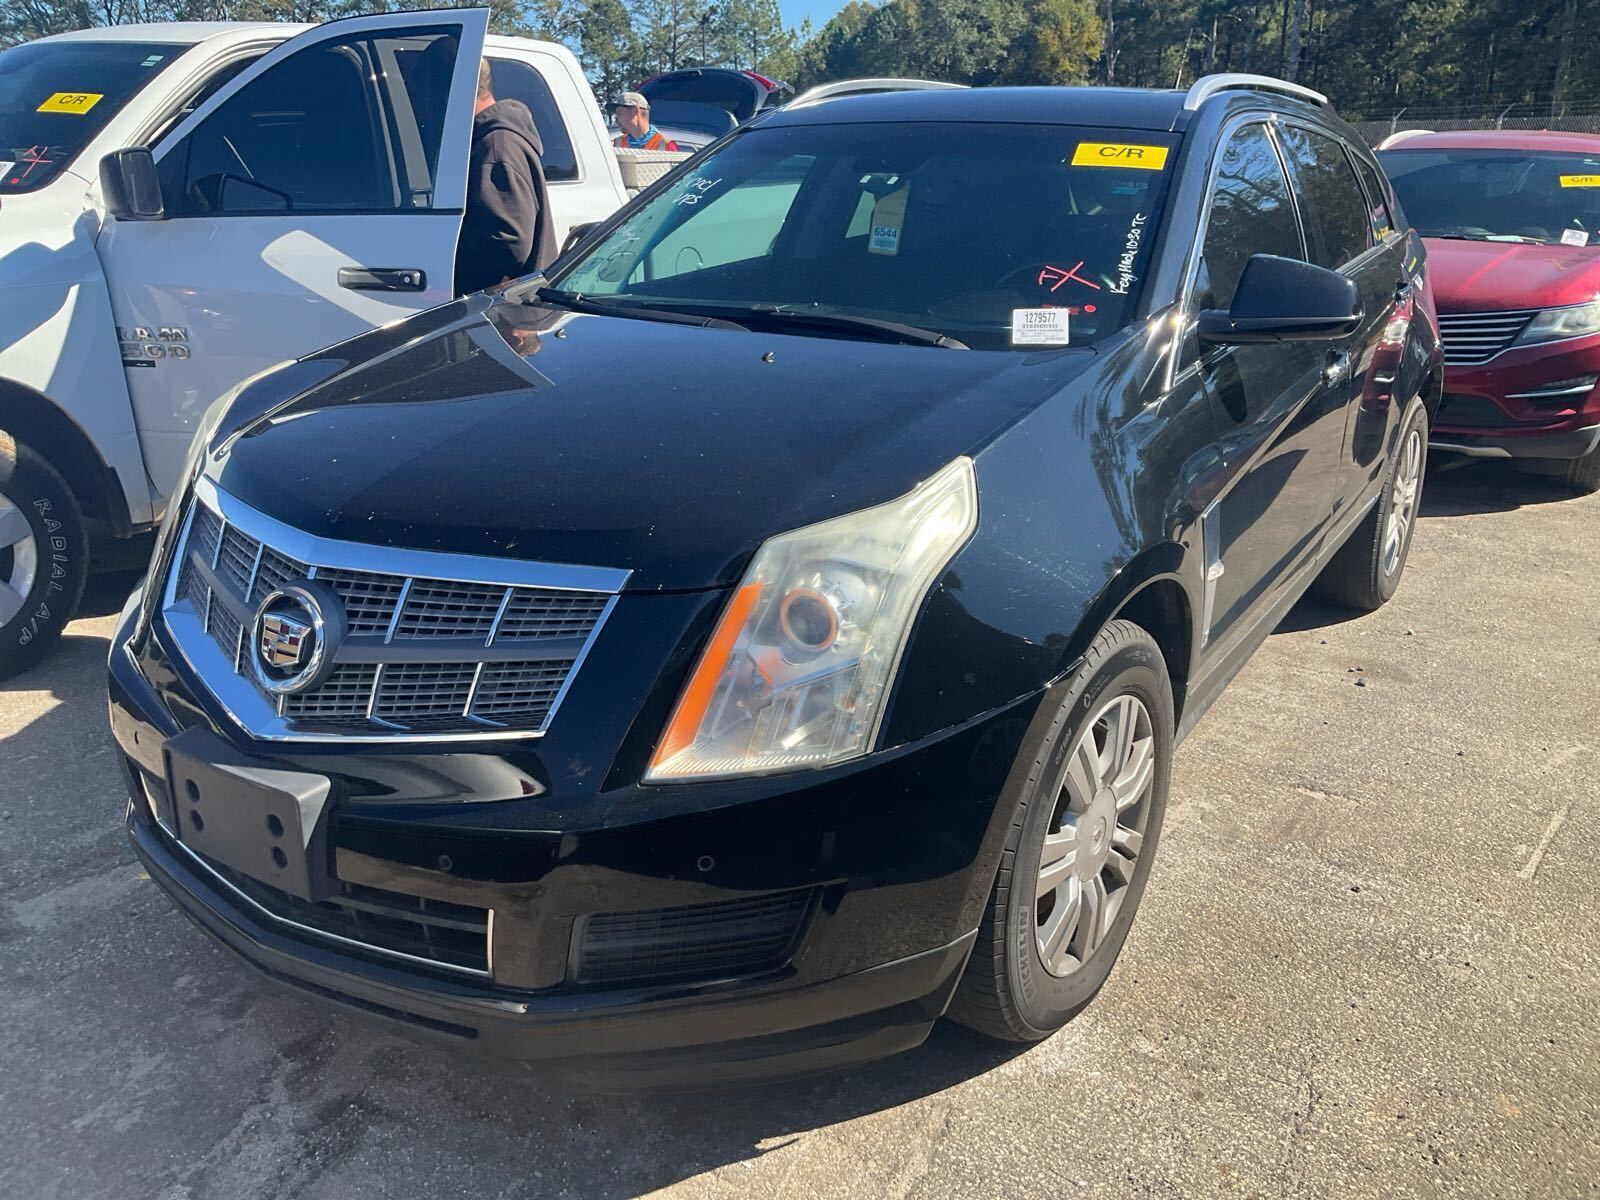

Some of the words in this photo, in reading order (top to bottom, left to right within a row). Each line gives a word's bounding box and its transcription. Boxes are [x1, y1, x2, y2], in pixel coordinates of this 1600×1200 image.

[59, 95, 87, 105] C/R
[1099, 147, 1145, 159] C/R
[875, 227, 897, 238] 6544
[1025, 312, 1056, 323] 1279577
[121, 343, 191, 359] 500
[33, 498, 67, 596] RADIAL
[19, 602, 51, 645] A/P
[1019, 911, 1036, 1000] MICHELIN
